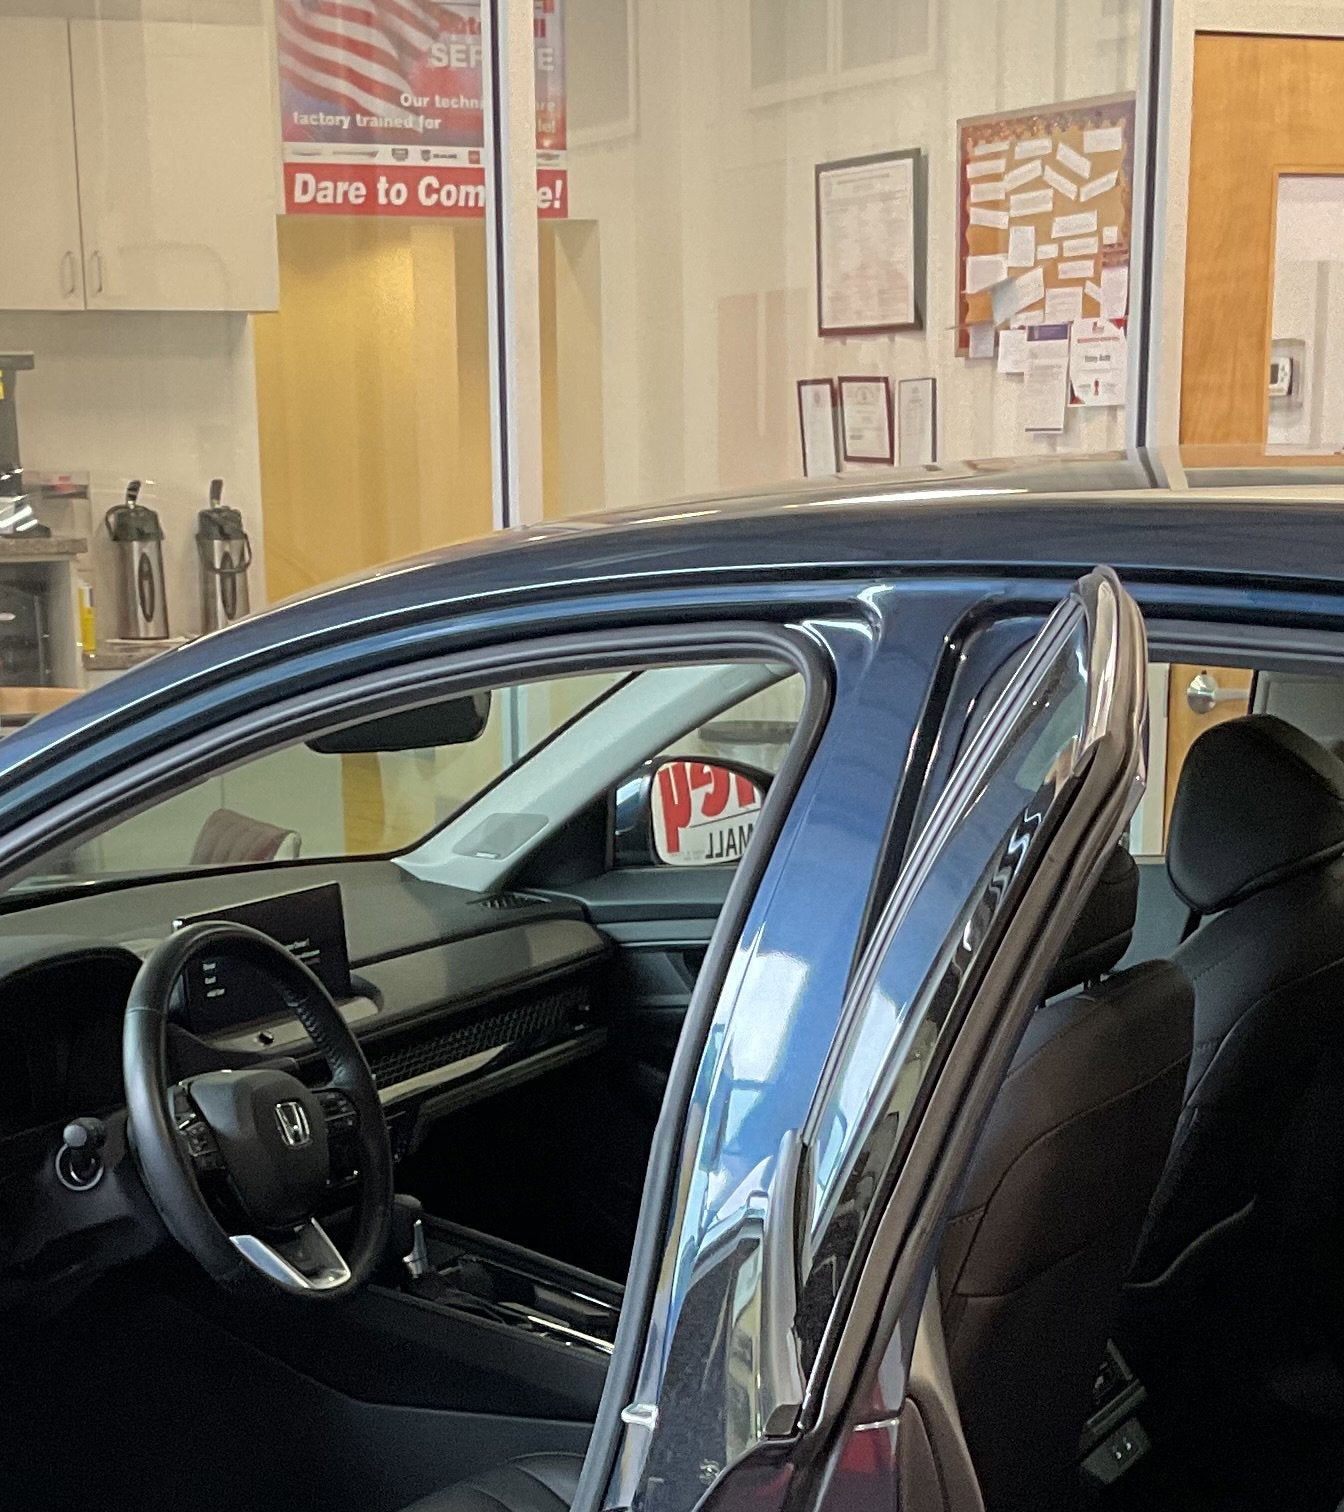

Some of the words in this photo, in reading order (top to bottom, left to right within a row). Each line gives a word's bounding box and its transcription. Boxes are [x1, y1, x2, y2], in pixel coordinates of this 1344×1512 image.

[400, 93, 430, 109] Our
[355, 113, 414, 129] trained
[418, 115, 442, 130] for
[294, 173, 367, 204] Dare
[376, 176, 407, 205] to
